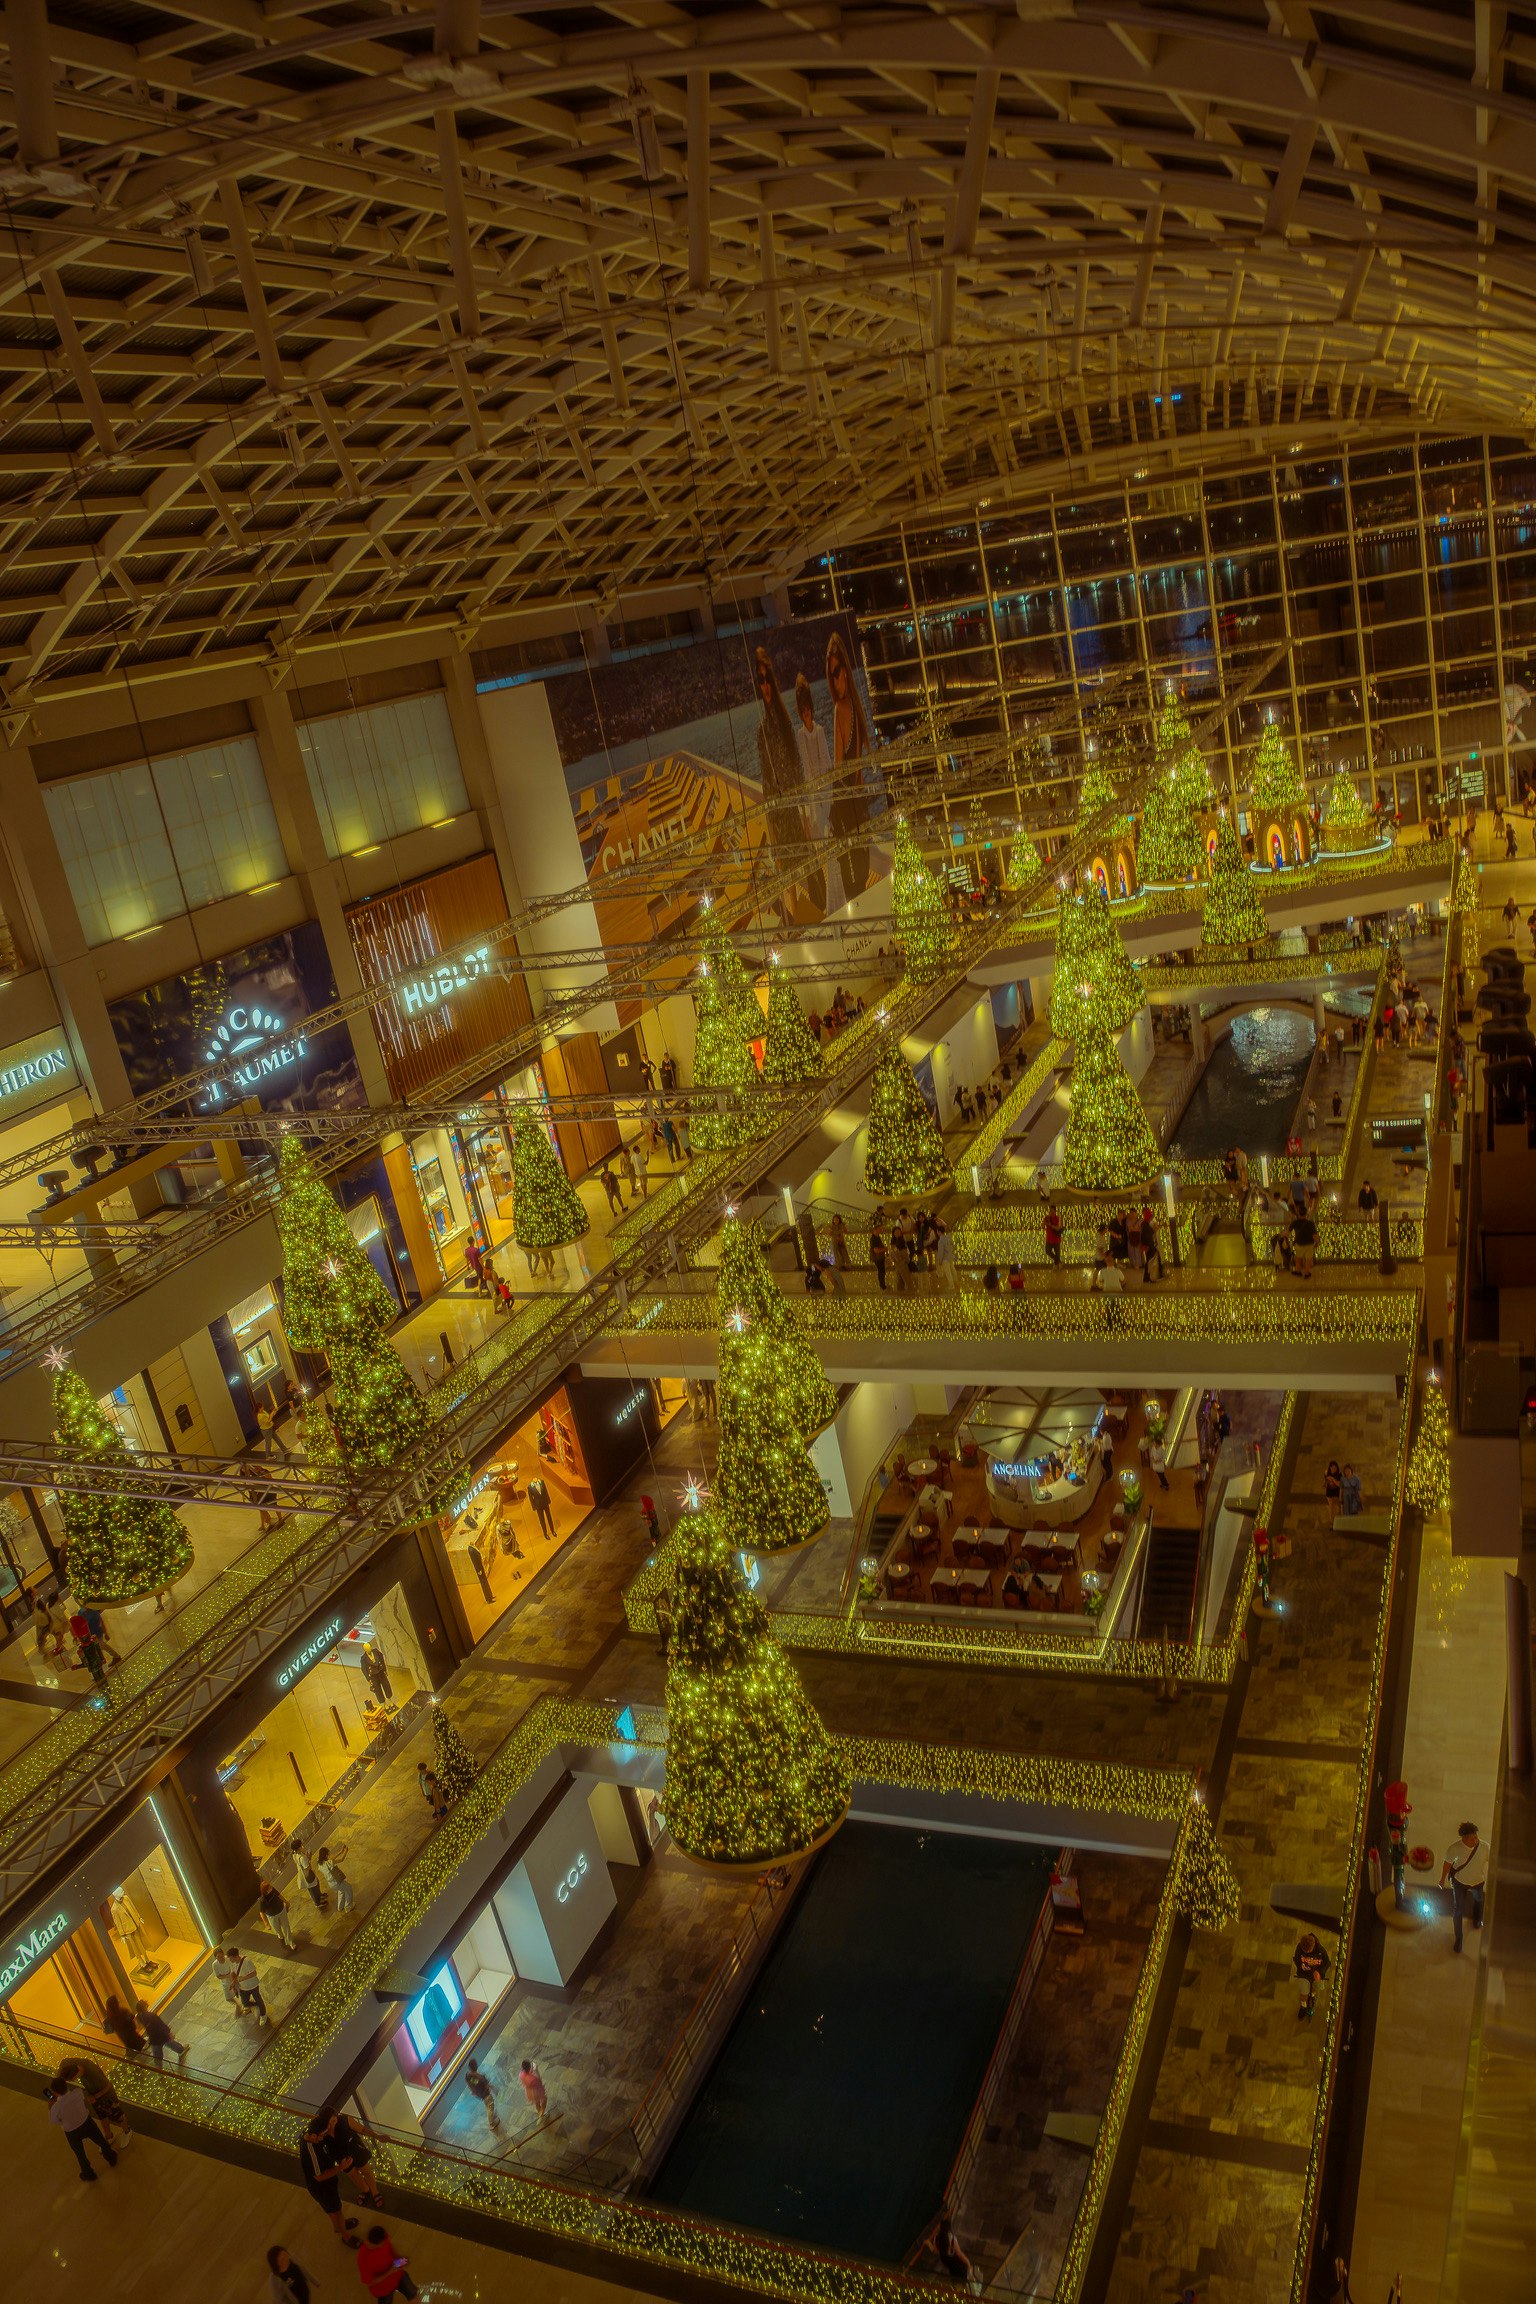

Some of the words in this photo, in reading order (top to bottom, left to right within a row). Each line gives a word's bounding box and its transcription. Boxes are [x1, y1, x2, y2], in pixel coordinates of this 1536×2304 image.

[403, 947, 489, 1014] HUBLOT
[0, 1048, 68, 1098] HERON
[200, 1034, 307, 1107] AUMET
[993, 1463, 1041, 1477] ANGELINA
[279, 1619, 340, 1686] GIVENCHY
[558, 1853, 588, 1903] COS
[0, 1913, 68, 1994] axMara
